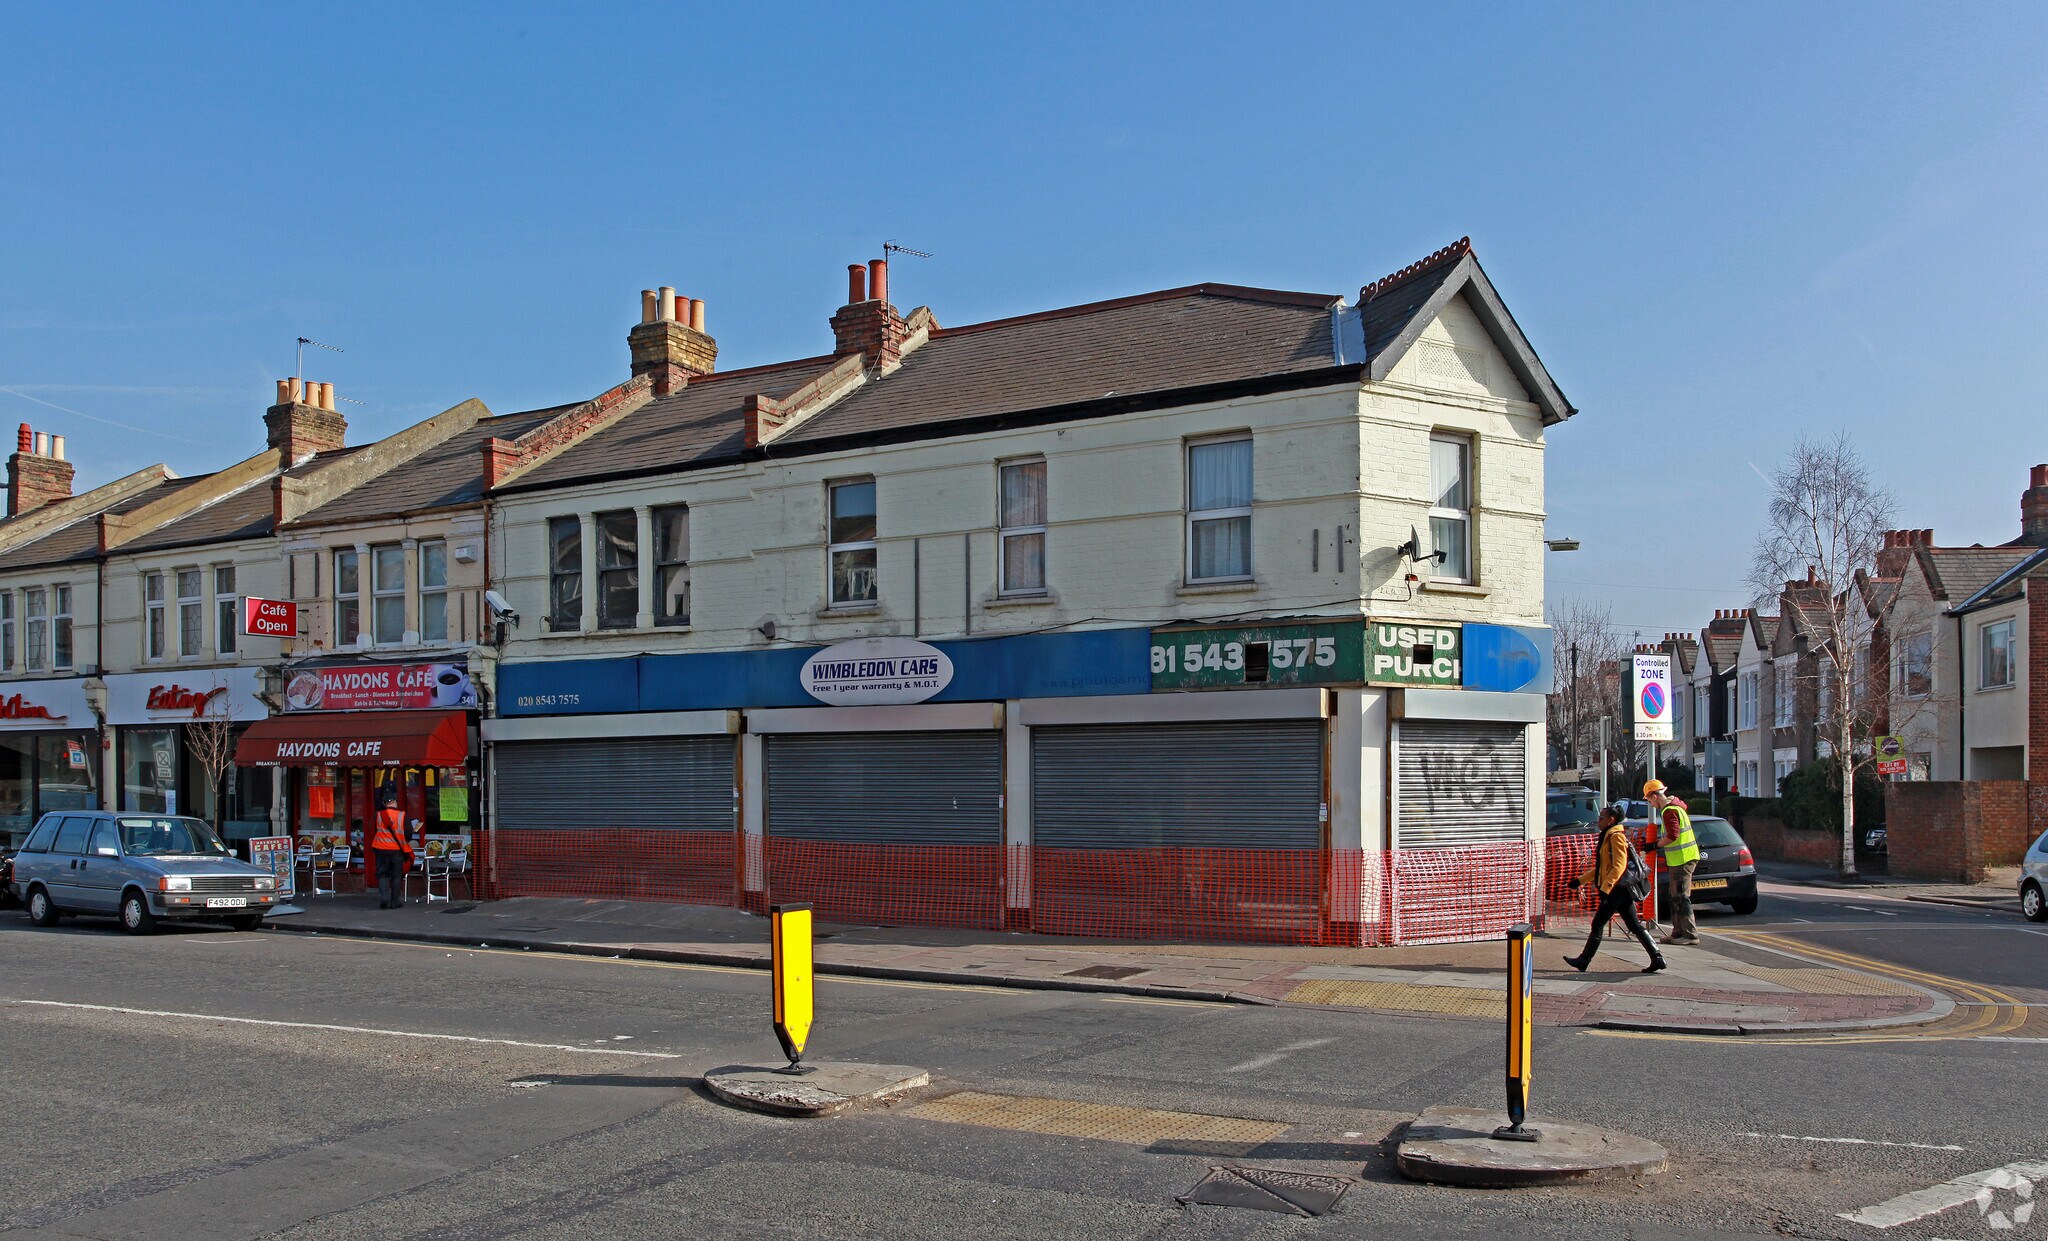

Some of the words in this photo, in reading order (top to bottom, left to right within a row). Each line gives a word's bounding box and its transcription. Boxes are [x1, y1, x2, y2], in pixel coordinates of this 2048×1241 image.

[260, 603, 287, 616] Café
[256, 618, 288, 633] Open
[1378, 626, 1456, 650] USED
[1151, 645, 1176, 673] 81
[1184, 642, 1244, 672] 543
[1635, 658, 1668, 667] Controlled
[812, 660, 897, 679] WIMBLEDON
[900, 659, 938, 675] CARS
[1640, 669, 1664, 679] ZONE
[323, 672, 389, 690] HAYDONS
[396, 668, 433, 688] CAFÉ
[839, 684, 859, 692] year
[861, 682, 902, 690] warranty
[913, 680, 939, 688] M.O.T.
[461, 696, 474, 705] 341
[518, 696, 533, 707] 020
[535, 694, 556, 706] 8543
[558, 694, 580, 705] 7575
[277, 742, 341, 757] HAYDONS
[347, 741, 382, 757] CAFE
[254, 843, 283, 851] CAFE
[208, 898, 229, 906] F492
